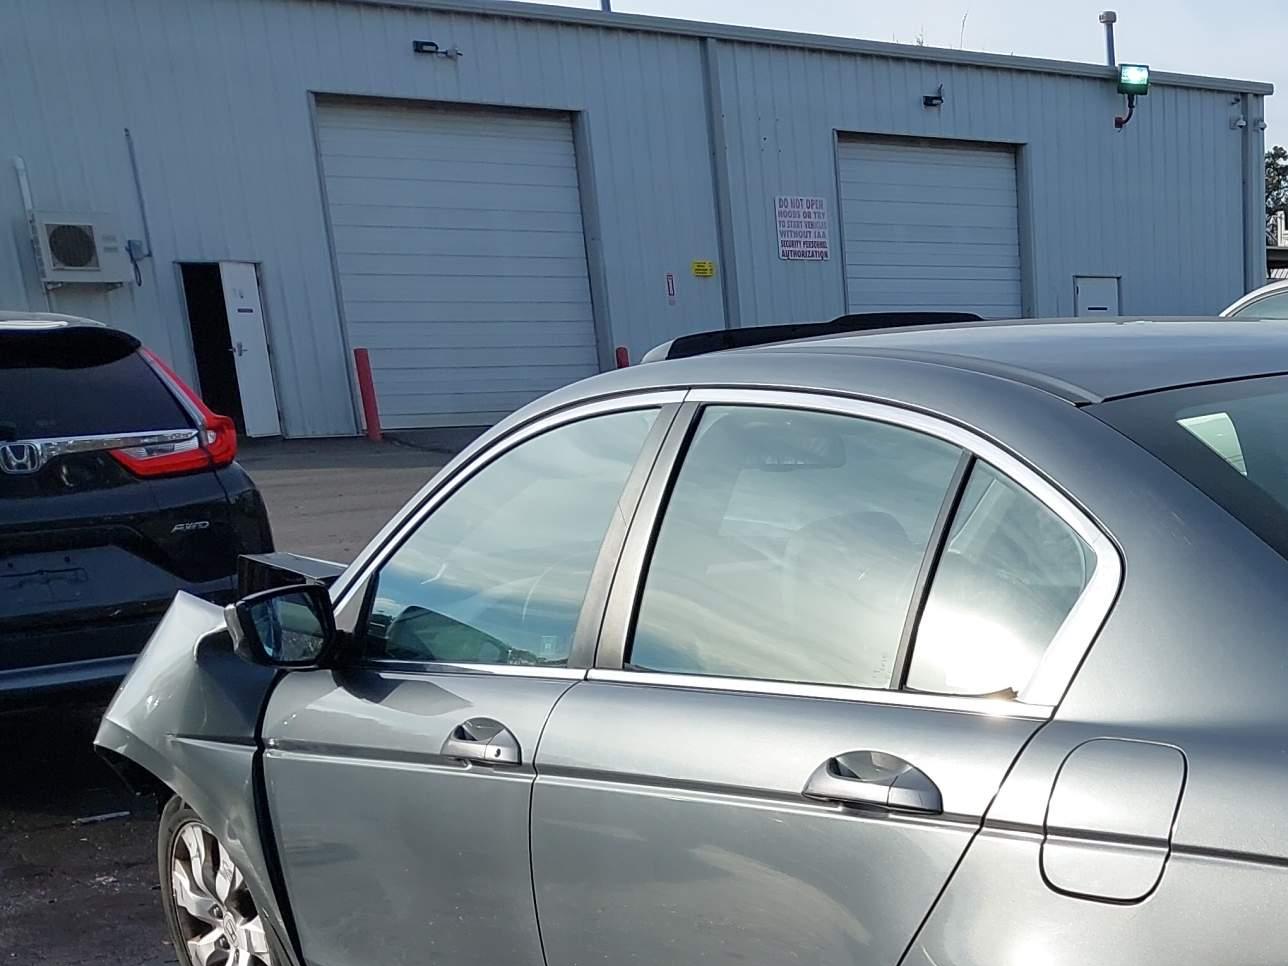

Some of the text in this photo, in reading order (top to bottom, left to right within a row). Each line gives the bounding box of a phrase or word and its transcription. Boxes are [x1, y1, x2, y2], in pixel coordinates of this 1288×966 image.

[779, 198, 824, 209] DO NOT OPEN
[802, 211, 812, 219] OR
[813, 211, 825, 219] TRY
[778, 220, 786, 228] TO
[787, 220, 803, 229] START
[779, 230, 826, 239] WITHOUT IAA
[780, 240, 828, 249] SECURITY PERSONNEL
[781, 249, 829, 258] AUTHORIZATION
